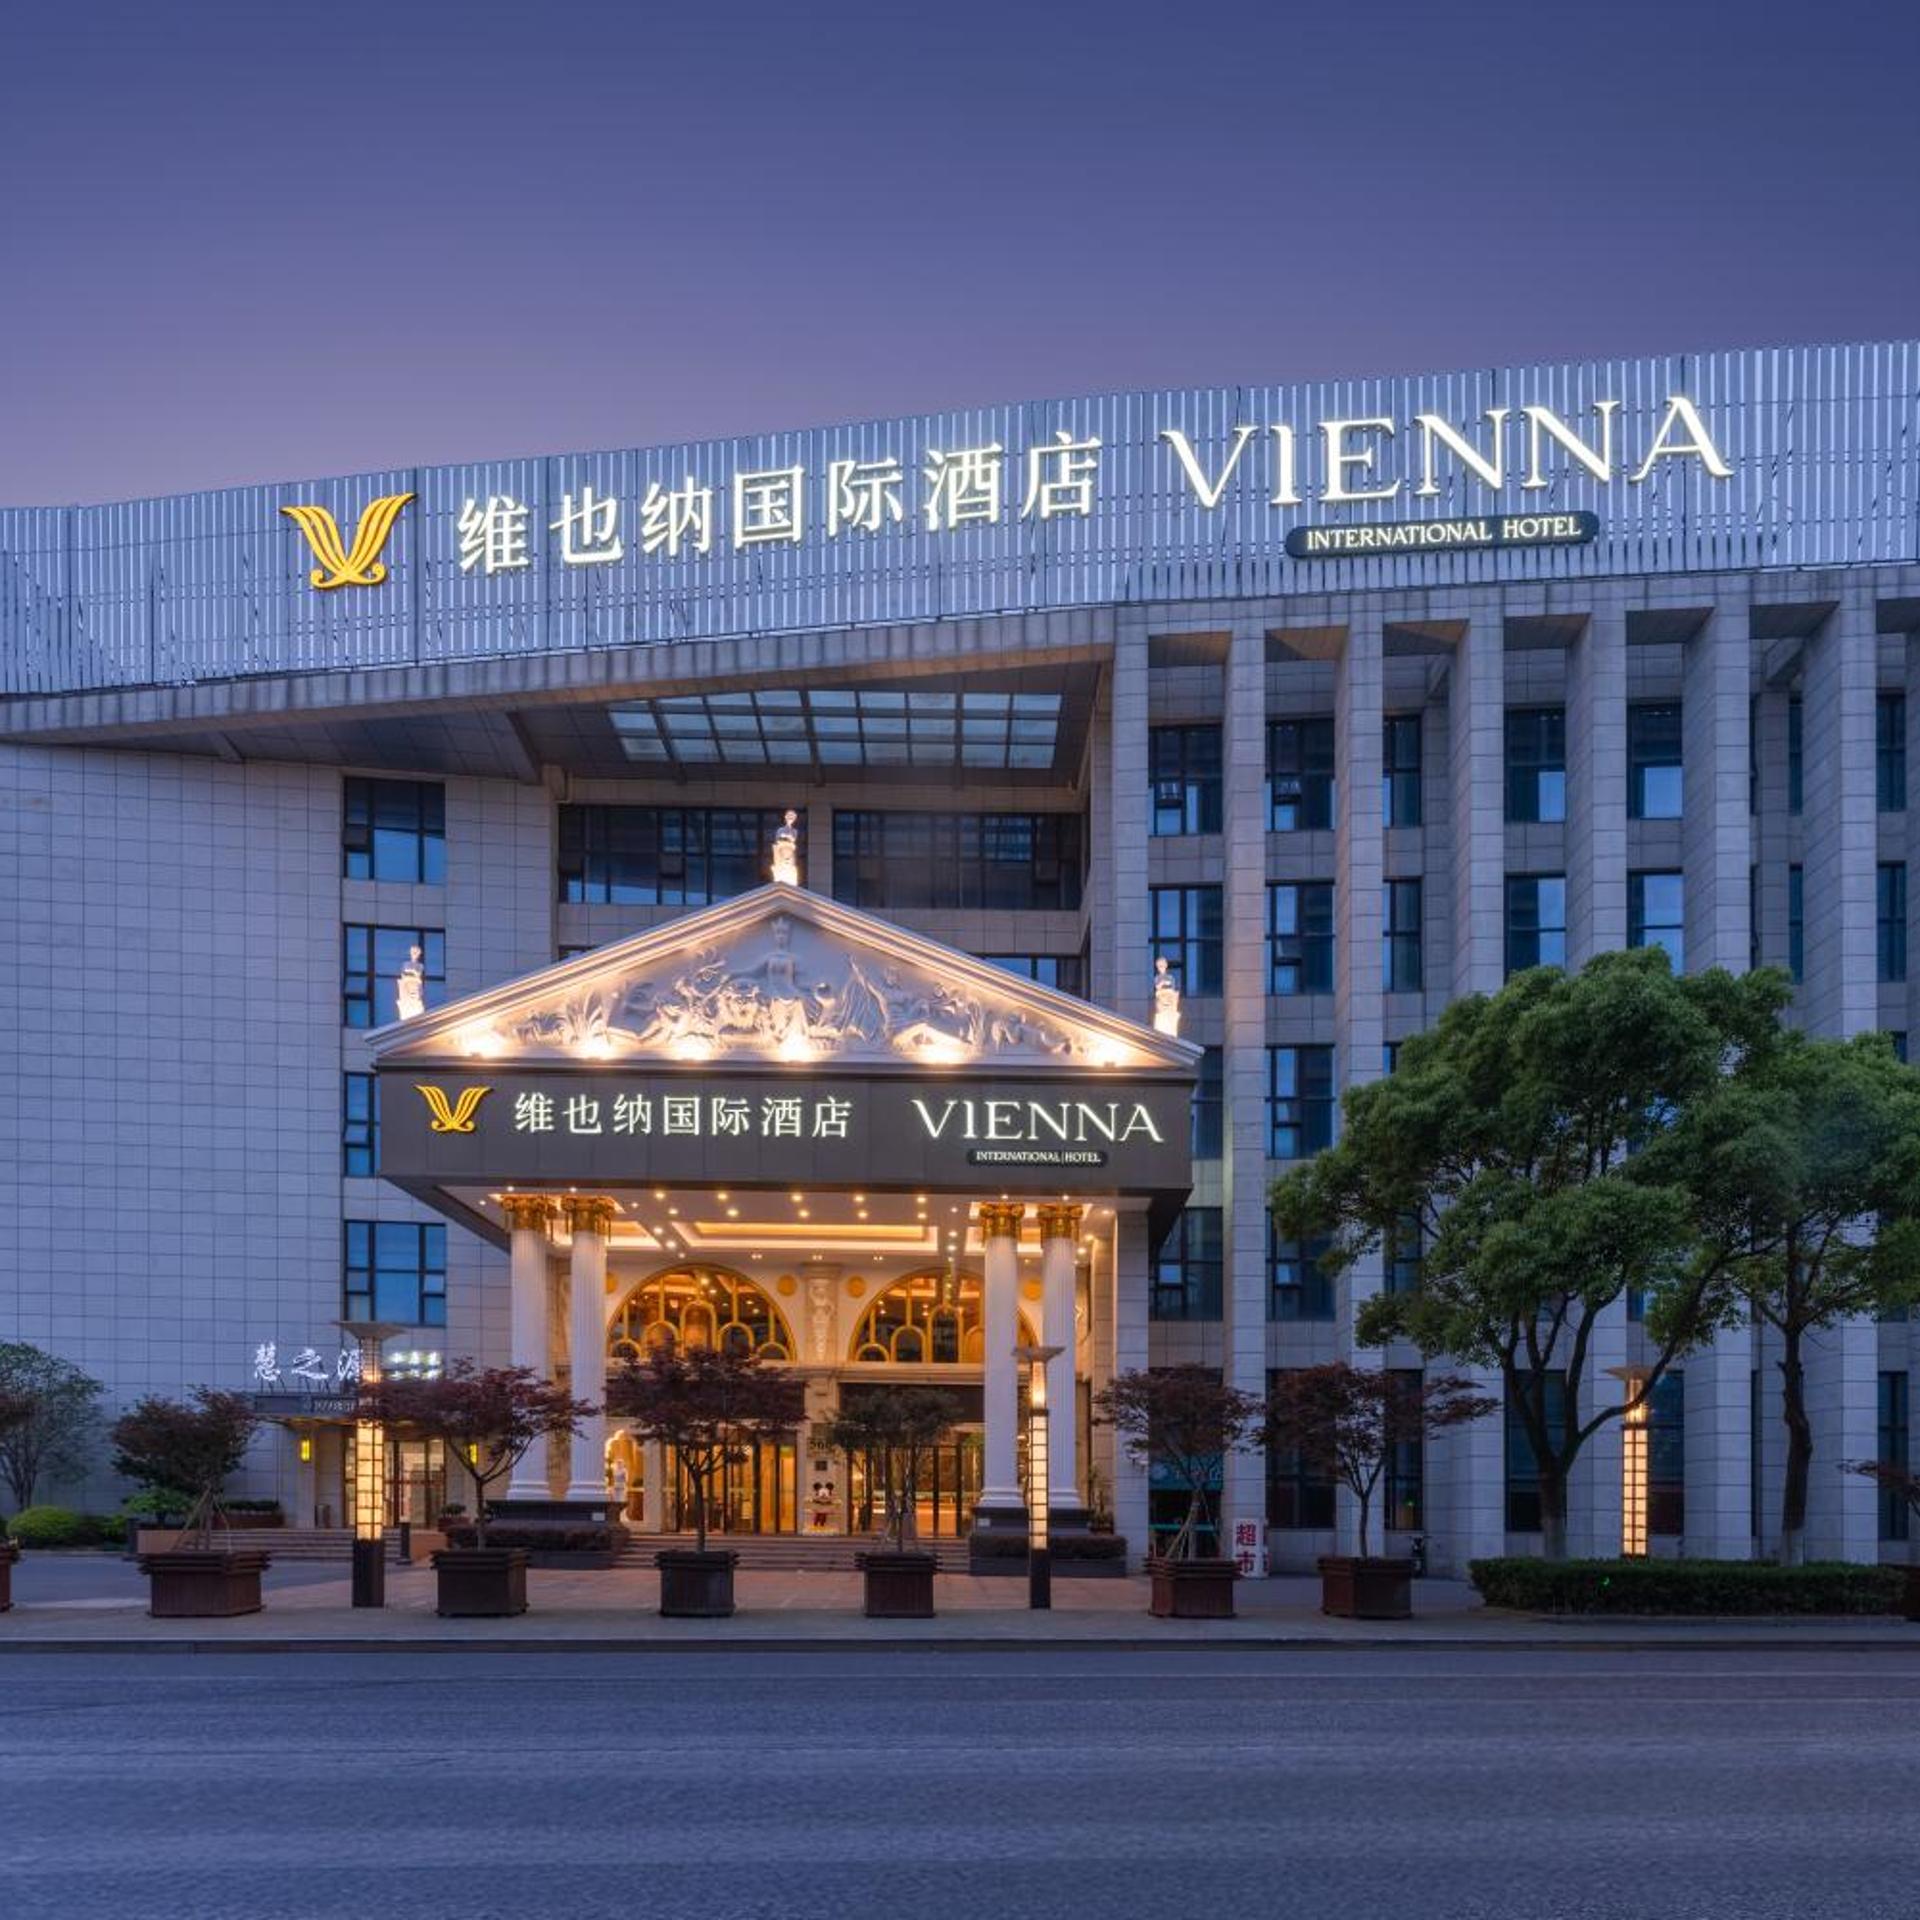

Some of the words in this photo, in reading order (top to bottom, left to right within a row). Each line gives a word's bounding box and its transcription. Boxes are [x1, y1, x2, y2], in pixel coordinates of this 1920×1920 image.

[1160, 396, 1735, 509] VIENNA
[456, 430, 1103, 575] 维也纳国际酒店
[1306, 521, 1492, 550] INTERNATIONAL
[1503, 515, 1583, 539] HOTEL
[513, 1091, 854, 1138] 维也纳国际酒店
[911, 1099, 1165, 1143] VIENNA
[976, 1150, 1060, 1163] INTERNATIONAL
[1065, 1151, 1102, 1163] HOTEL
[1236, 1523, 1257, 1574] 超市
